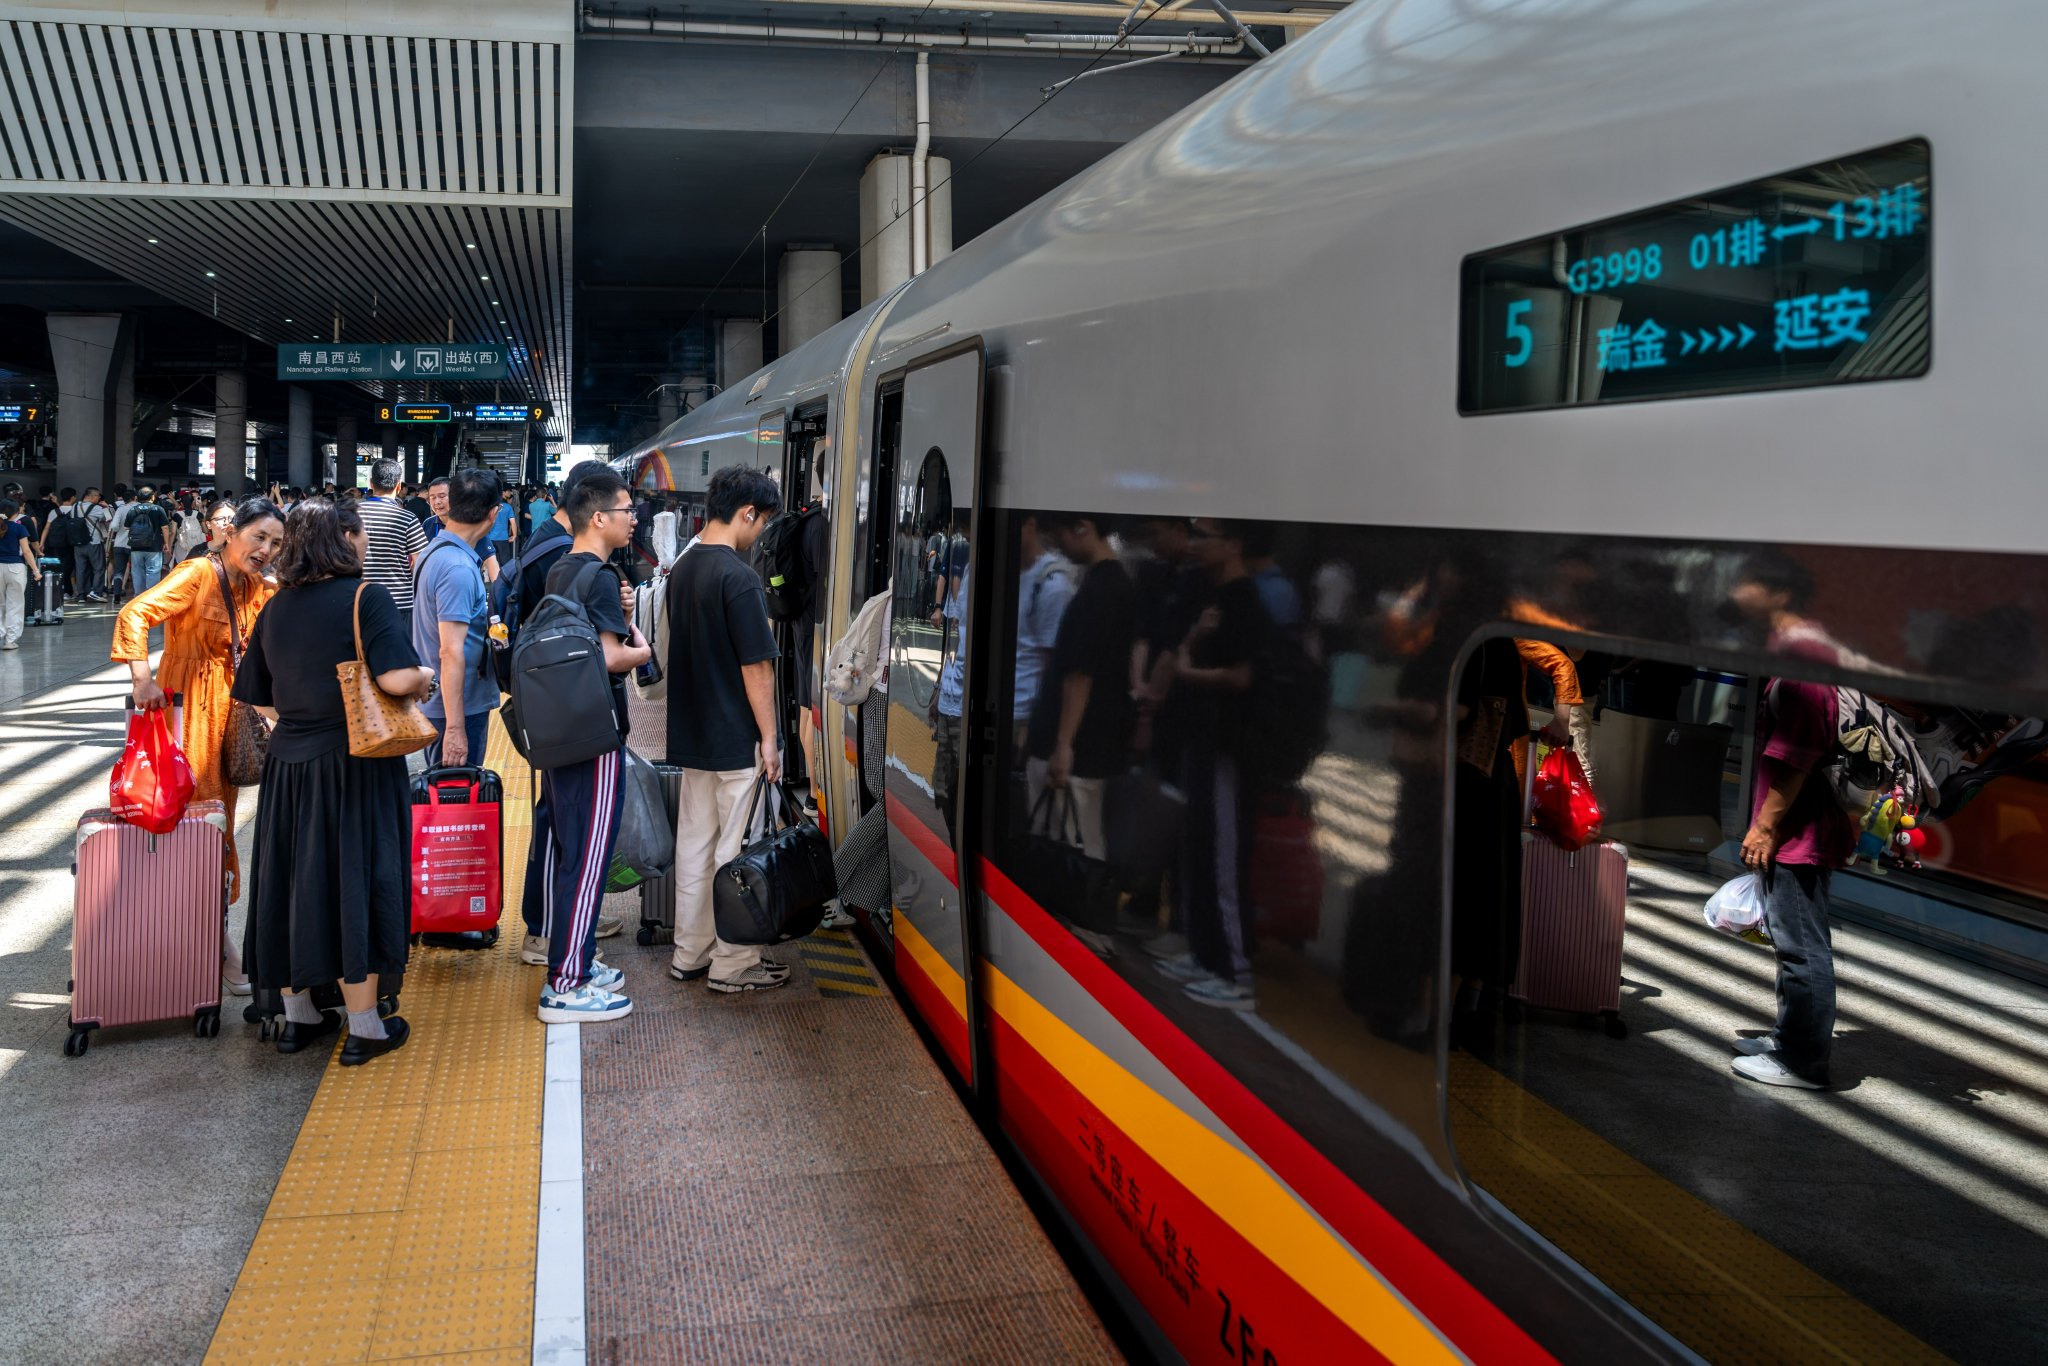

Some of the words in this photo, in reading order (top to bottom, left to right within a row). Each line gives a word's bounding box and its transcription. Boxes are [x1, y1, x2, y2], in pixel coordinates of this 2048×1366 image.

[1568, 243, 1662, 294] G3998
[1688, 217, 1767, 270] 01排
[1826, 182, 1924, 242] 13排
[1504, 298, 1533, 368] 5
[1597, 318, 1668, 372] 瑞金
[1773, 287, 1871, 353] 延安
[298, 350, 361, 365] 南昌西站
[445, 350, 499, 365] 出站(西)
[286, 366, 323, 374] Nanchangxi
[324, 366, 349, 374] Railway
[27, 408, 38, 421] 7
[381, 408, 390, 420] 8
[534, 407, 543, 420] 9
